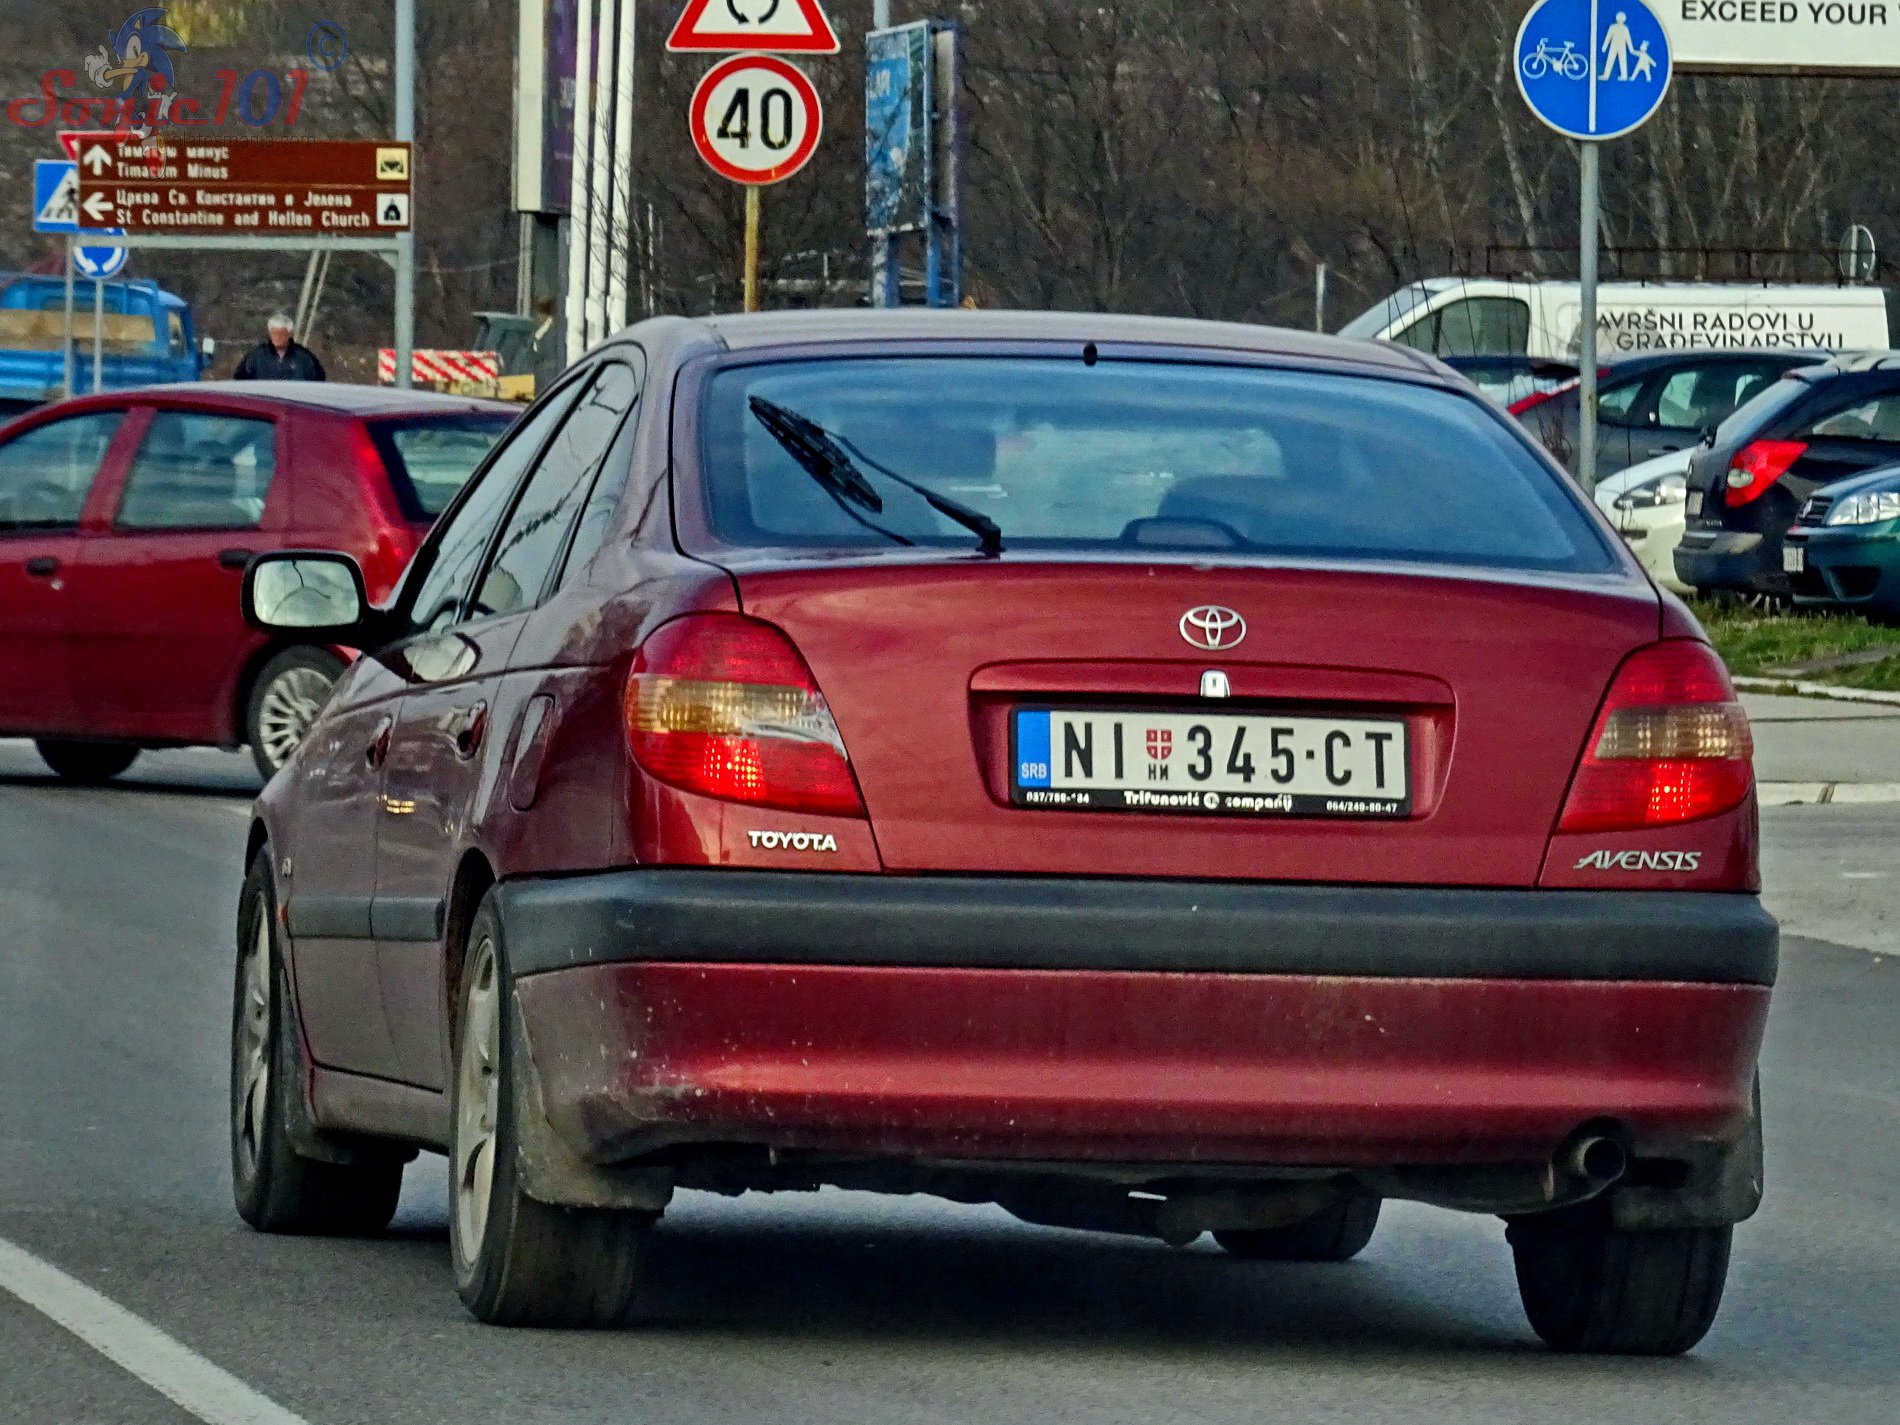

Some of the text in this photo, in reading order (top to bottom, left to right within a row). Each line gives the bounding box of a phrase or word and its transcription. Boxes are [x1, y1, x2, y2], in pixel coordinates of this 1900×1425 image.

[1681, 0, 1887, 25] EXCEED YOUR
[717, 88, 792, 149] 40
[187, 162, 229, 179] Minus
[142, 208, 224, 226] Constantine
[234, 211, 259, 227] and
[268, 209, 312, 227] Hellen
[321, 210, 370, 228] Church
[1596, 308, 1815, 331] AVRŠNI RADOVI U
[1021, 762, 1047, 779] SRB
[747, 830, 838, 852] TOYOTA
[1573, 850, 1702, 871] AVENSIS
